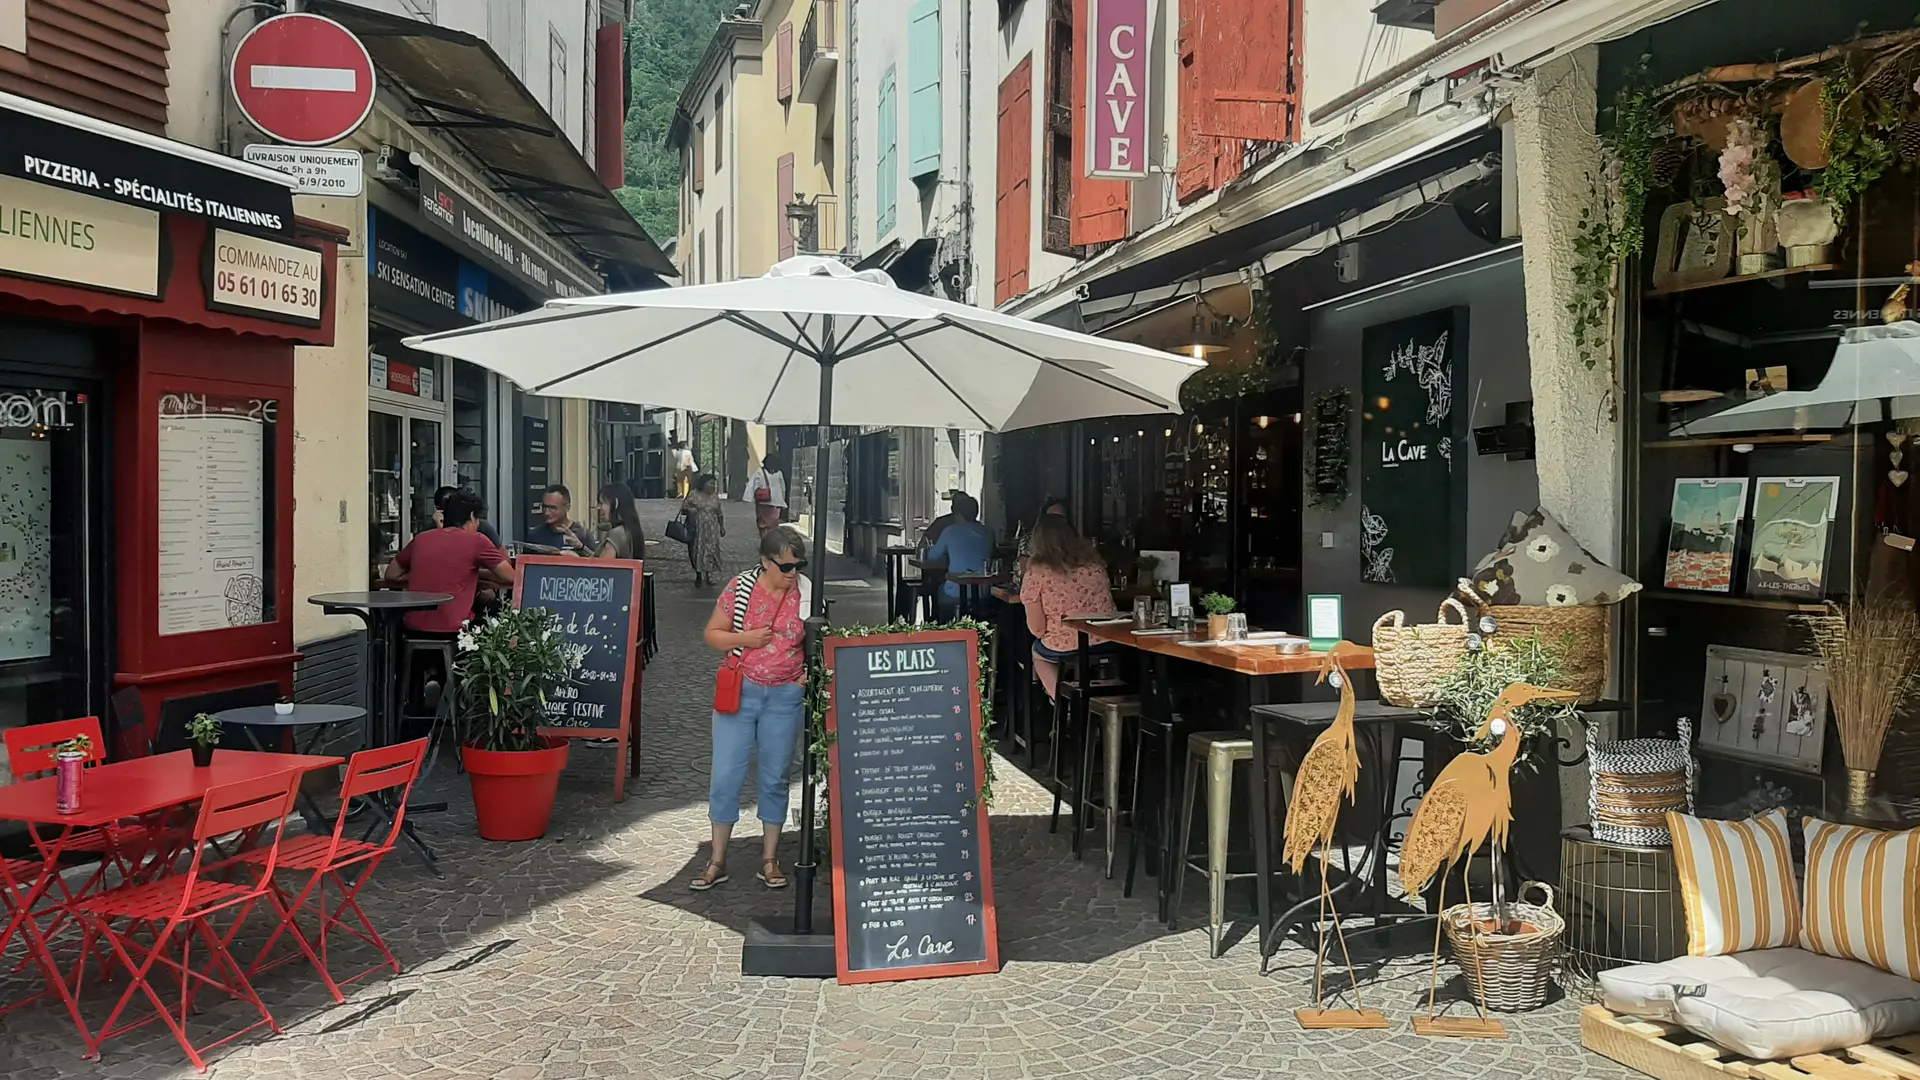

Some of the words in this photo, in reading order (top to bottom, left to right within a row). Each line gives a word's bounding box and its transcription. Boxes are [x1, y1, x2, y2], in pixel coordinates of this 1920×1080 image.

[1104, 25, 1138, 171] CAVE
[247, 152, 296, 163] LIVRAISON
[299, 154, 360, 167] UNIQUEMENT
[292, 166, 304, 174] 5h
[314, 166, 327, 175] 9h
[24, 154, 100, 190] PIZZERIA
[114, 177, 203, 214] SPÉCIALITÉS
[206, 200, 283, 230] ITALIENNES
[463, 209, 495, 252] Location
[218, 244, 300, 278] COMMANDEZ
[302, 263, 319, 282] AU
[217, 270, 236, 293] 05
[239, 275, 256, 297] 61
[261, 279, 277, 301] 01
[281, 283, 298, 304] 65
[301, 287, 317, 308] 30
[377, 261, 391, 281] SKI
[391, 267, 431, 300] SENSATION
[431, 286, 456, 310] CENTRE
[1382, 441, 1395, 462] La
[1397, 439, 1428, 461] Cave
[539, 577, 614, 602] MERCREDI
[566, 611, 579, 635] de
[583, 612, 601, 636] la
[867, 649, 892, 672] LES
[896, 647, 936, 671] PLATS
[573, 701, 607, 719] FESTIVE
[885, 934, 913, 963] La
[917, 934, 955, 957] Cave
